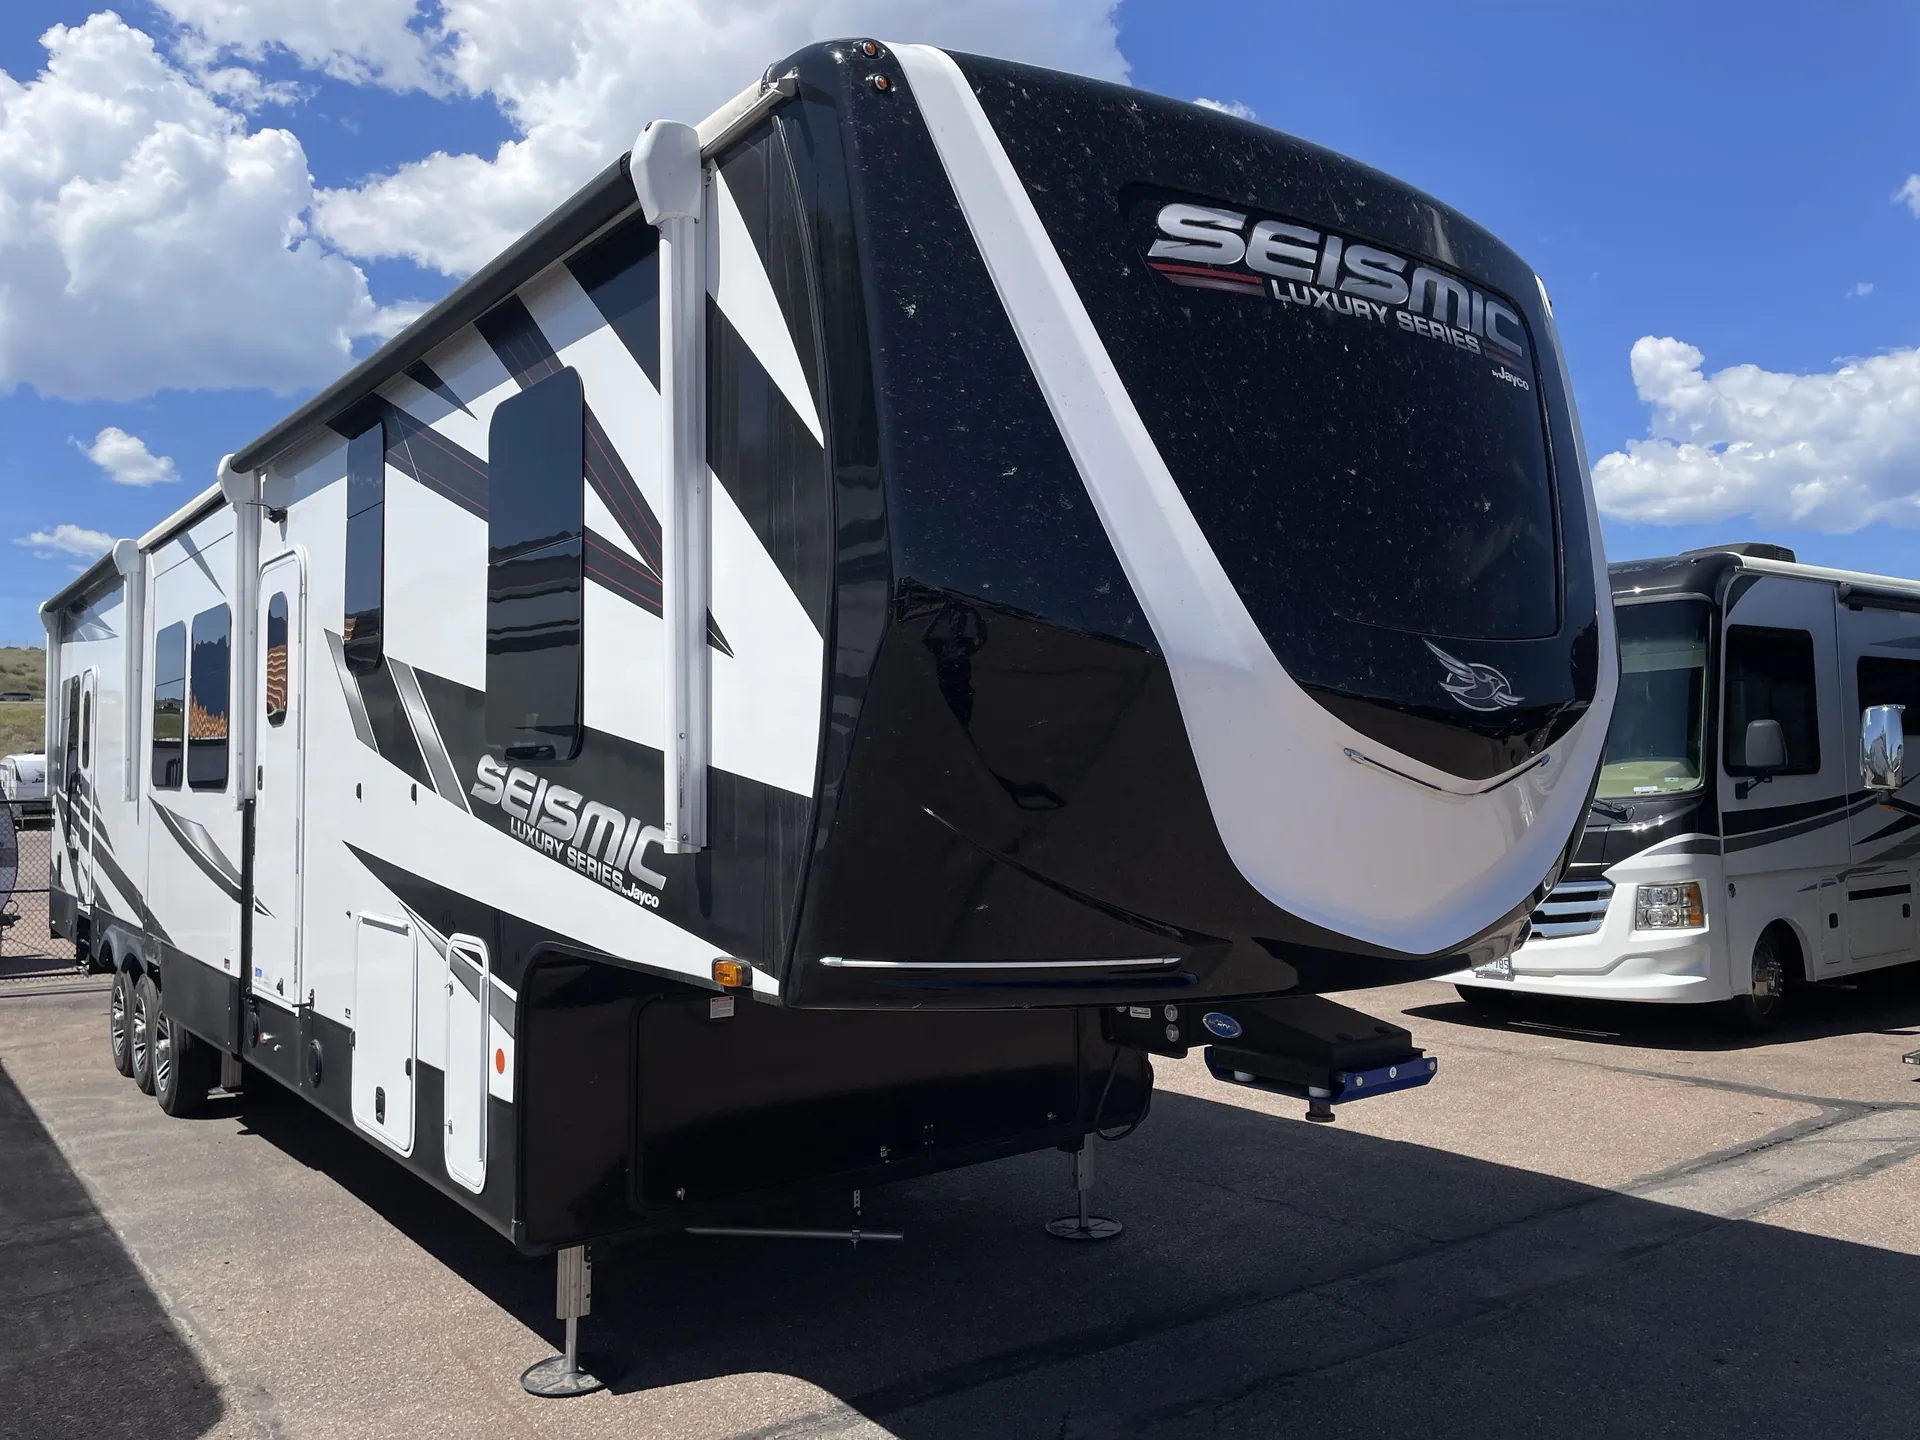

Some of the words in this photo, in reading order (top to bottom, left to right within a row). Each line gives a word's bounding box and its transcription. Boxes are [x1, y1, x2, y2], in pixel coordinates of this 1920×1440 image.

[1147, 203, 1522, 358] SEISMIC
[1271, 279, 1388, 325] LUXURY
[1396, 310, 1482, 356] SERIES
[1500, 366, 1529, 391] Jayco
[470, 754, 667, 891] SEISMIC
[510, 817, 564, 859] LUXURY
[566, 846, 623, 893] SERIES
[627, 882, 660, 908] Jayco
